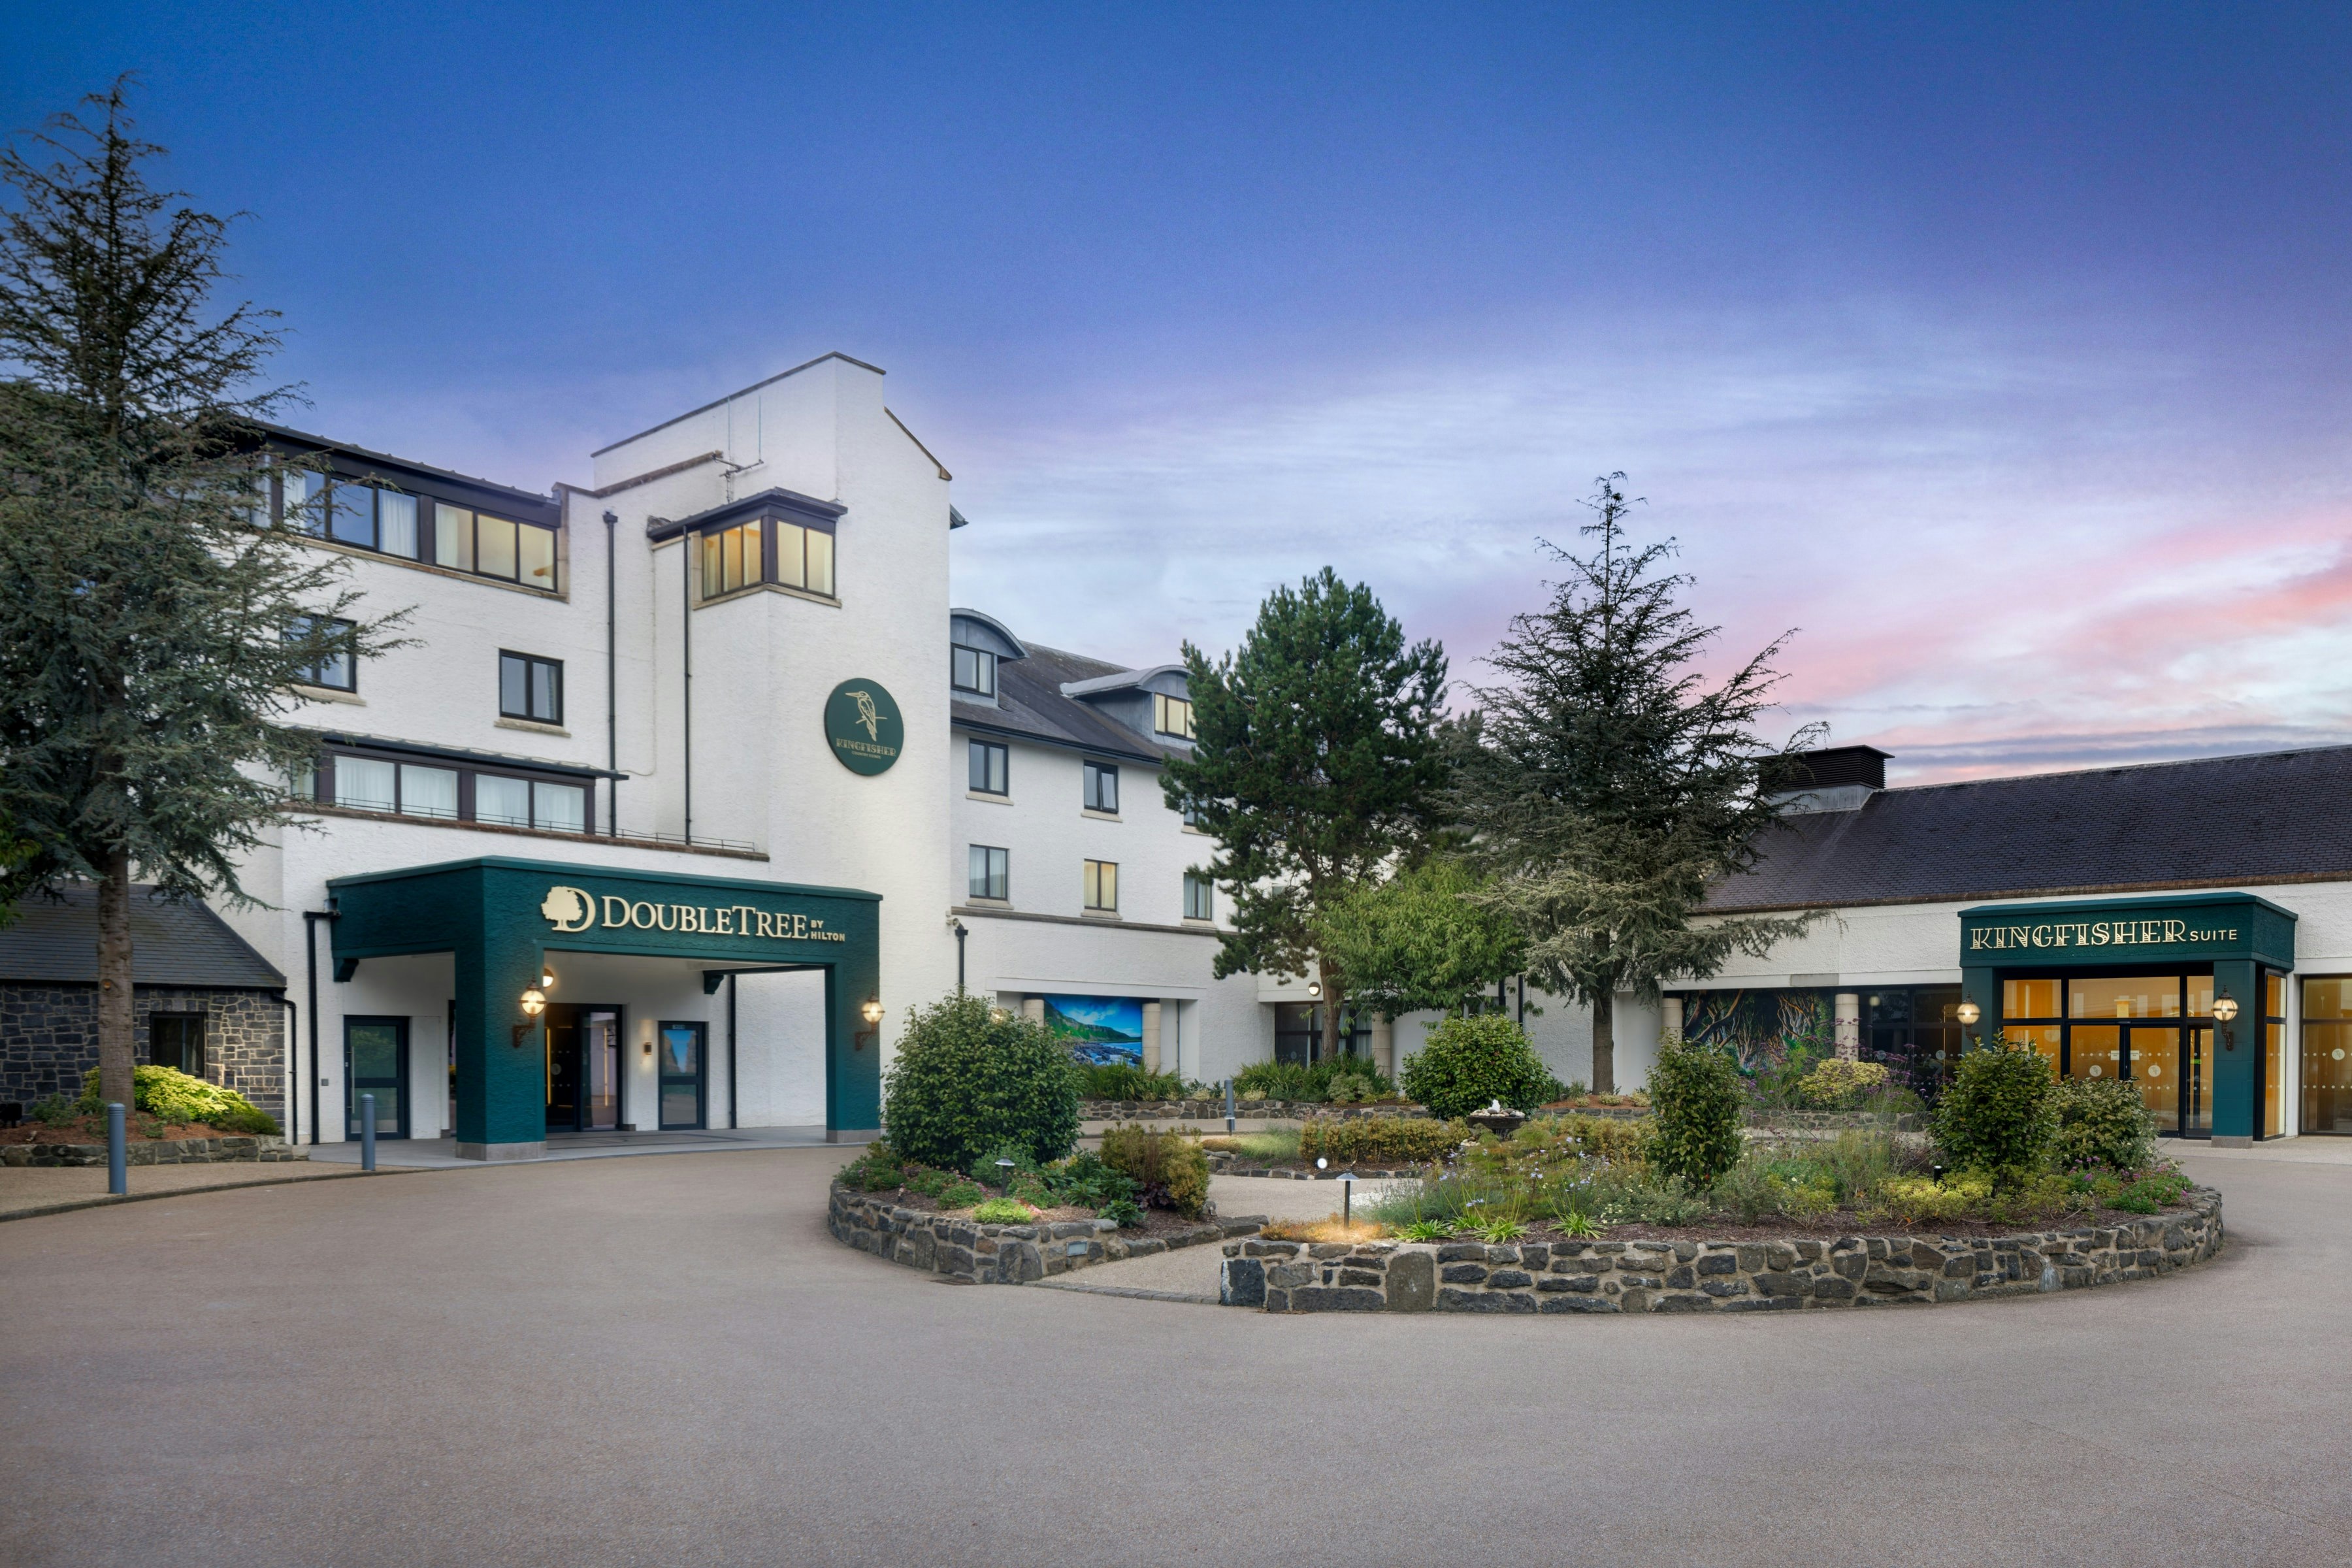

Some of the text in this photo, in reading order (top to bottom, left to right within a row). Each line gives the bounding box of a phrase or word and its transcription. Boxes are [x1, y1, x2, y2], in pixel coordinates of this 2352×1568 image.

[836, 738, 896, 757] KINGFISHER
[811, 920, 824, 928] BY
[811, 931, 845, 941] HILTON
[1970, 920, 2237, 949] KINGFISHER SUITE
